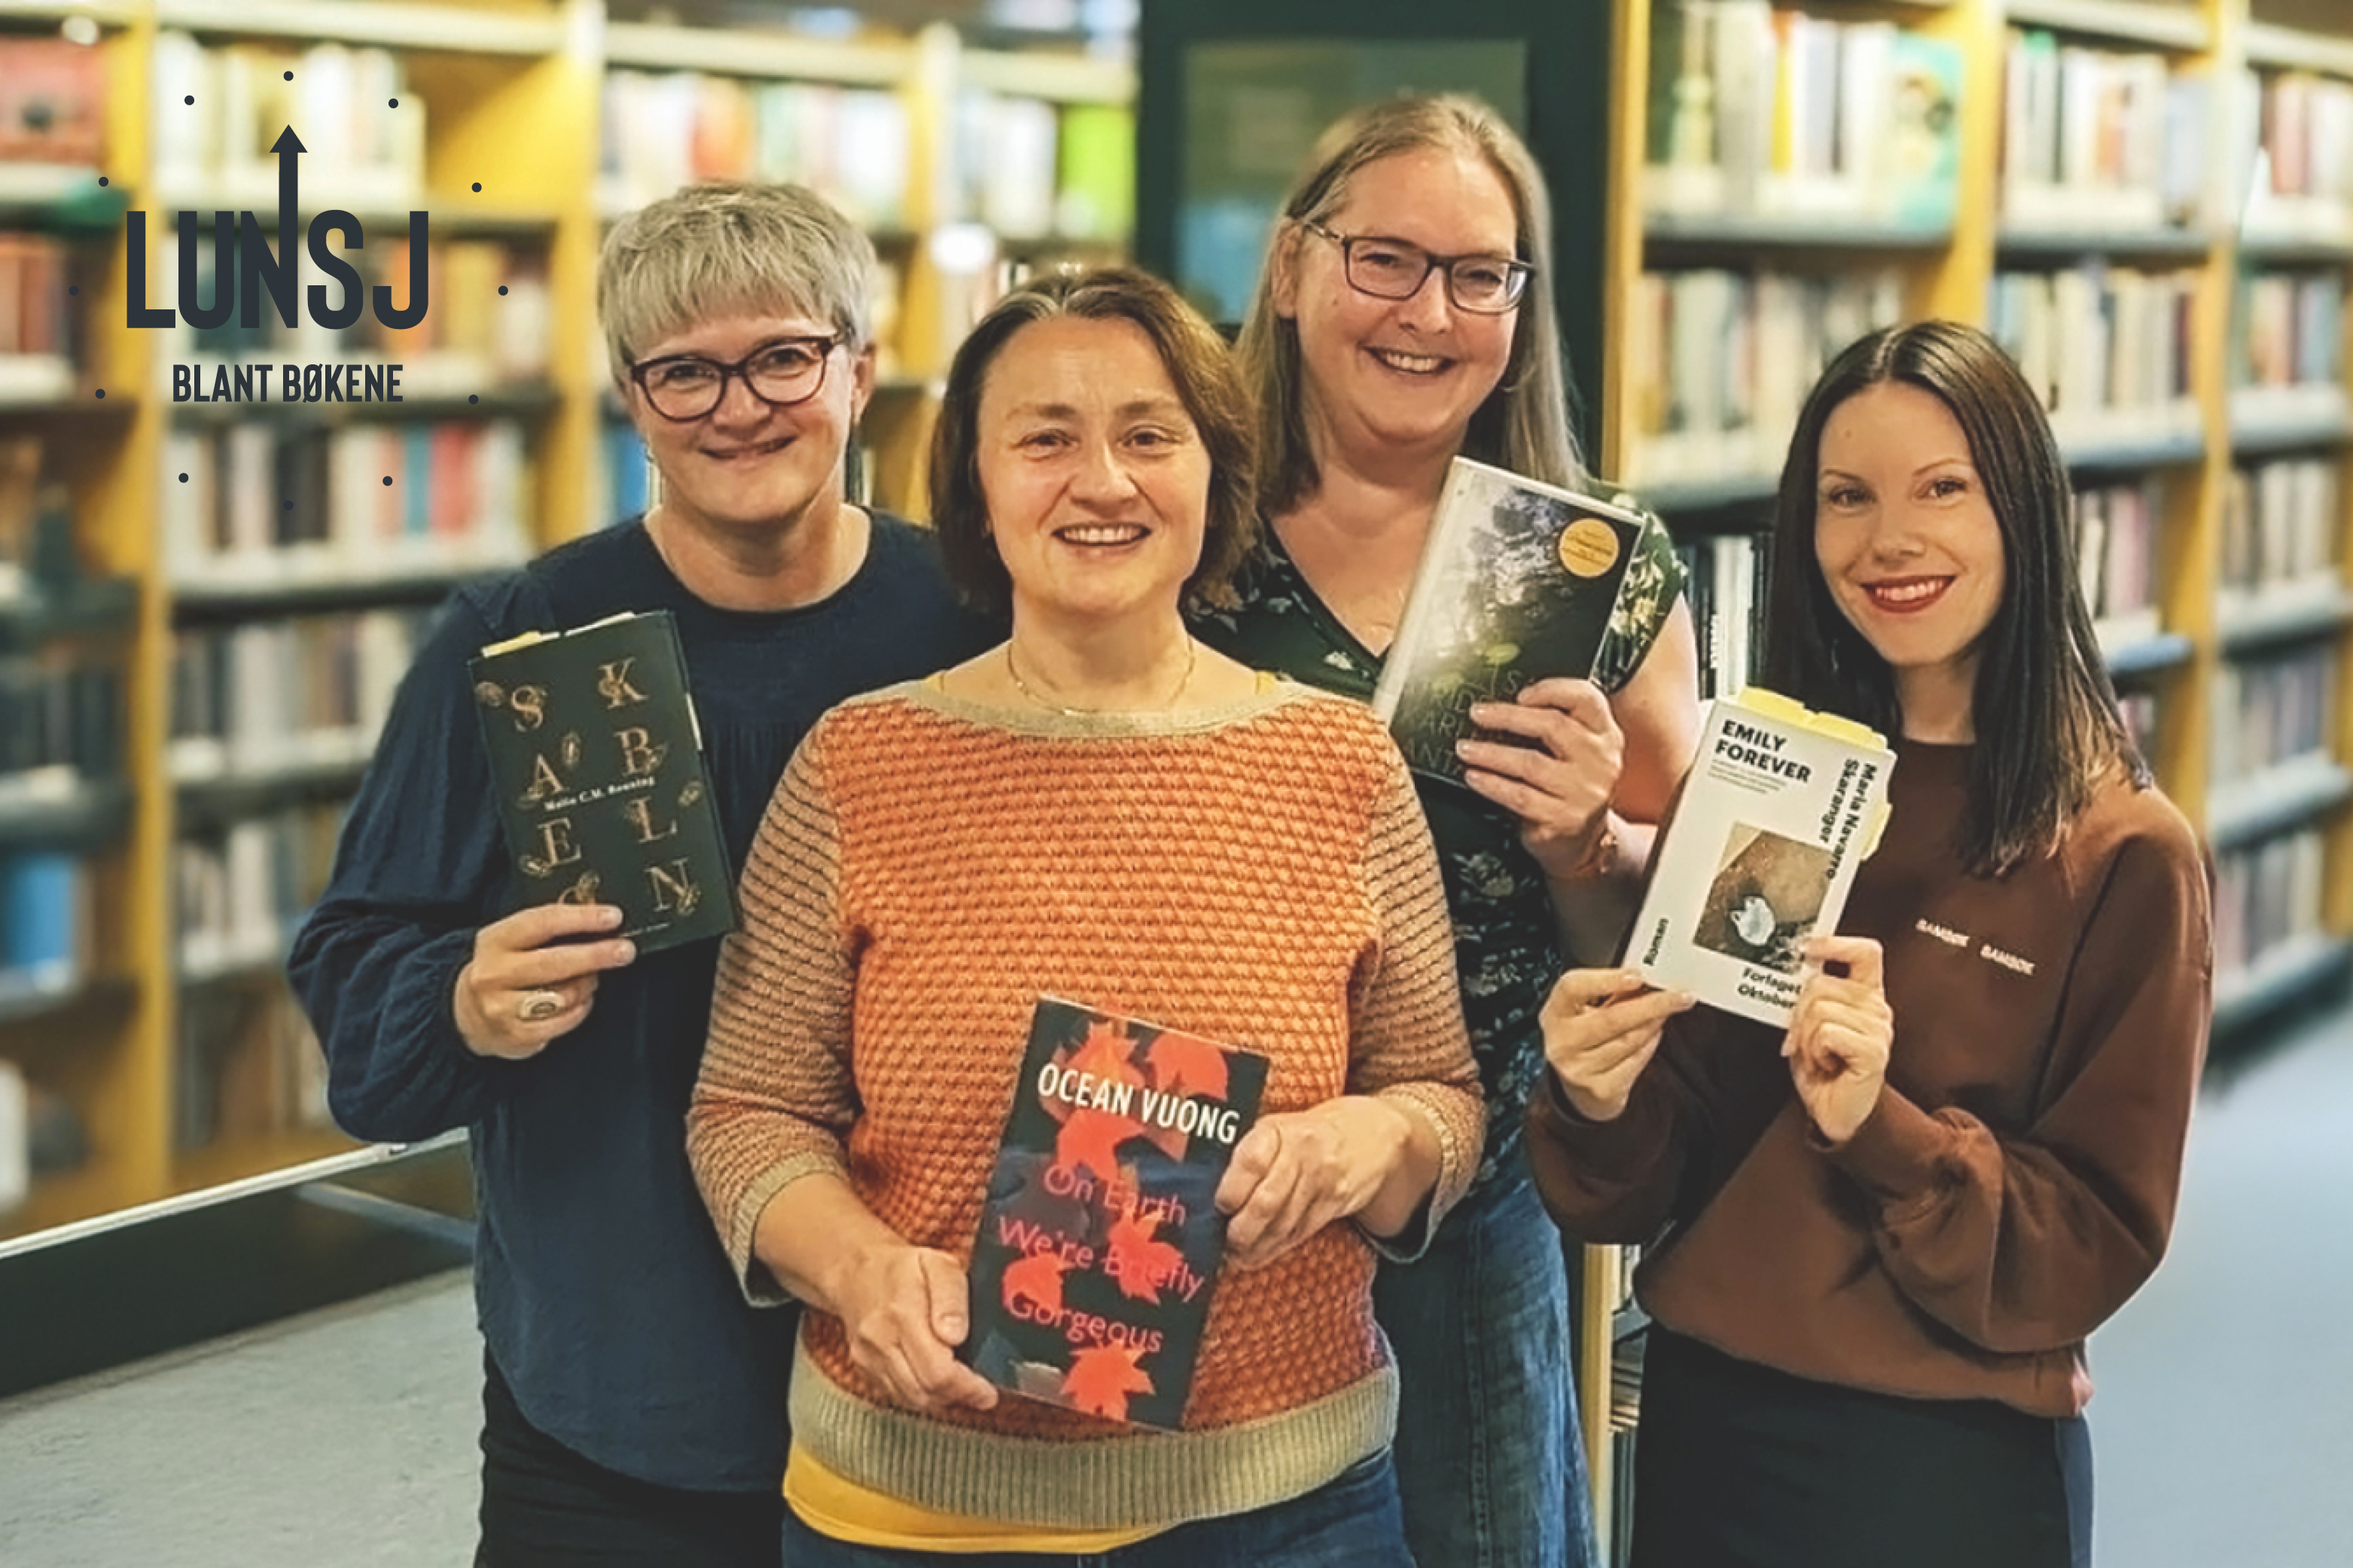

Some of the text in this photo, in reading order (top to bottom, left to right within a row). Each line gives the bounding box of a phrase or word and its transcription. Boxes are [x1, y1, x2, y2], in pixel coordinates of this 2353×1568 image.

[1715, 738, 1812, 783] FOREVER
[1722, 720, 1788, 751] EMILY
[1819, 759, 1860, 844] Skaranger
[1827, 763, 1878, 880] Maria Navarro
[1642, 918, 1669, 967] Roman
[1737, 983, 1797, 1009] Oktober
[1742, 967, 1802, 994] Forlaget
[1038, 1064, 1241, 1143] OCEAN VUONG
[1043, 1164, 1187, 1225] On Earth
[998, 1216, 1206, 1303] We're Briefly
[1007, 1291, 1164, 1353] Gorgeous
